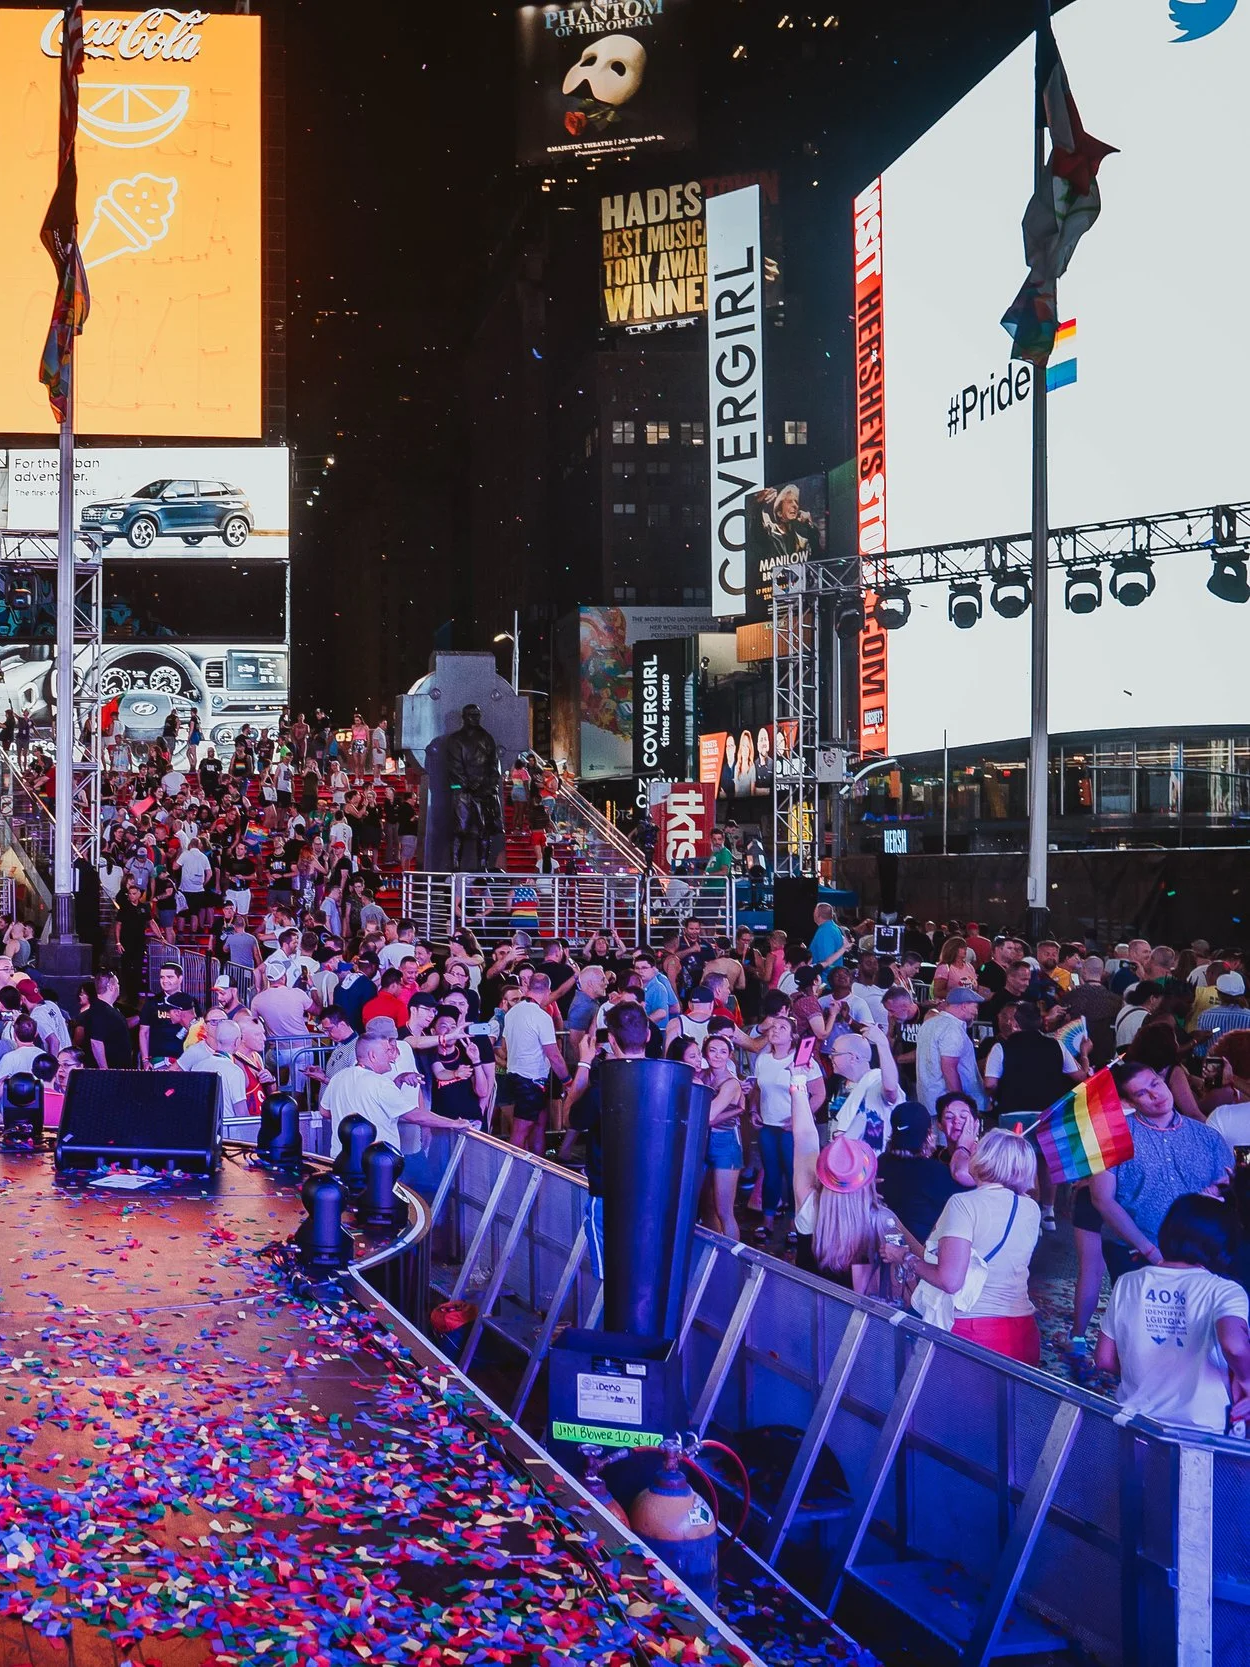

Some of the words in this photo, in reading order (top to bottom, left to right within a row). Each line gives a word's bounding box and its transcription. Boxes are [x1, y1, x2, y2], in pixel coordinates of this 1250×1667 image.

[544, 0, 664, 29] PHANTOM
[555, 26, 574, 38] OF
[576, 21, 604, 35] THE
[605, 16, 653, 31] OPERA
[40, 8, 210, 60] Cca-Cola
[603, 228, 643, 259] BEST
[854, 175, 882, 285] VISIT
[604, 254, 653, 287] TONY
[947, 362, 1031, 438] #Pride
[714, 245, 757, 597] COVERGIRL
[14, 471, 89, 482] adventer.
[15, 458, 35, 469] For
[37, 458, 58, 469] the
[74, 458, 100, 469] ban
[759, 550, 809, 573] MANILOW
[661, 673, 673, 713] square
[642, 654, 658, 767] COVERGIRL
[661, 715, 671, 748] times
[667, 789, 705, 867] tkts
[883, 829, 907, 854] HERSH
[1145, 1289, 1186, 1305] 40%
[614, 1429, 631, 1443] 10
[634, 1433, 645, 1446] of
